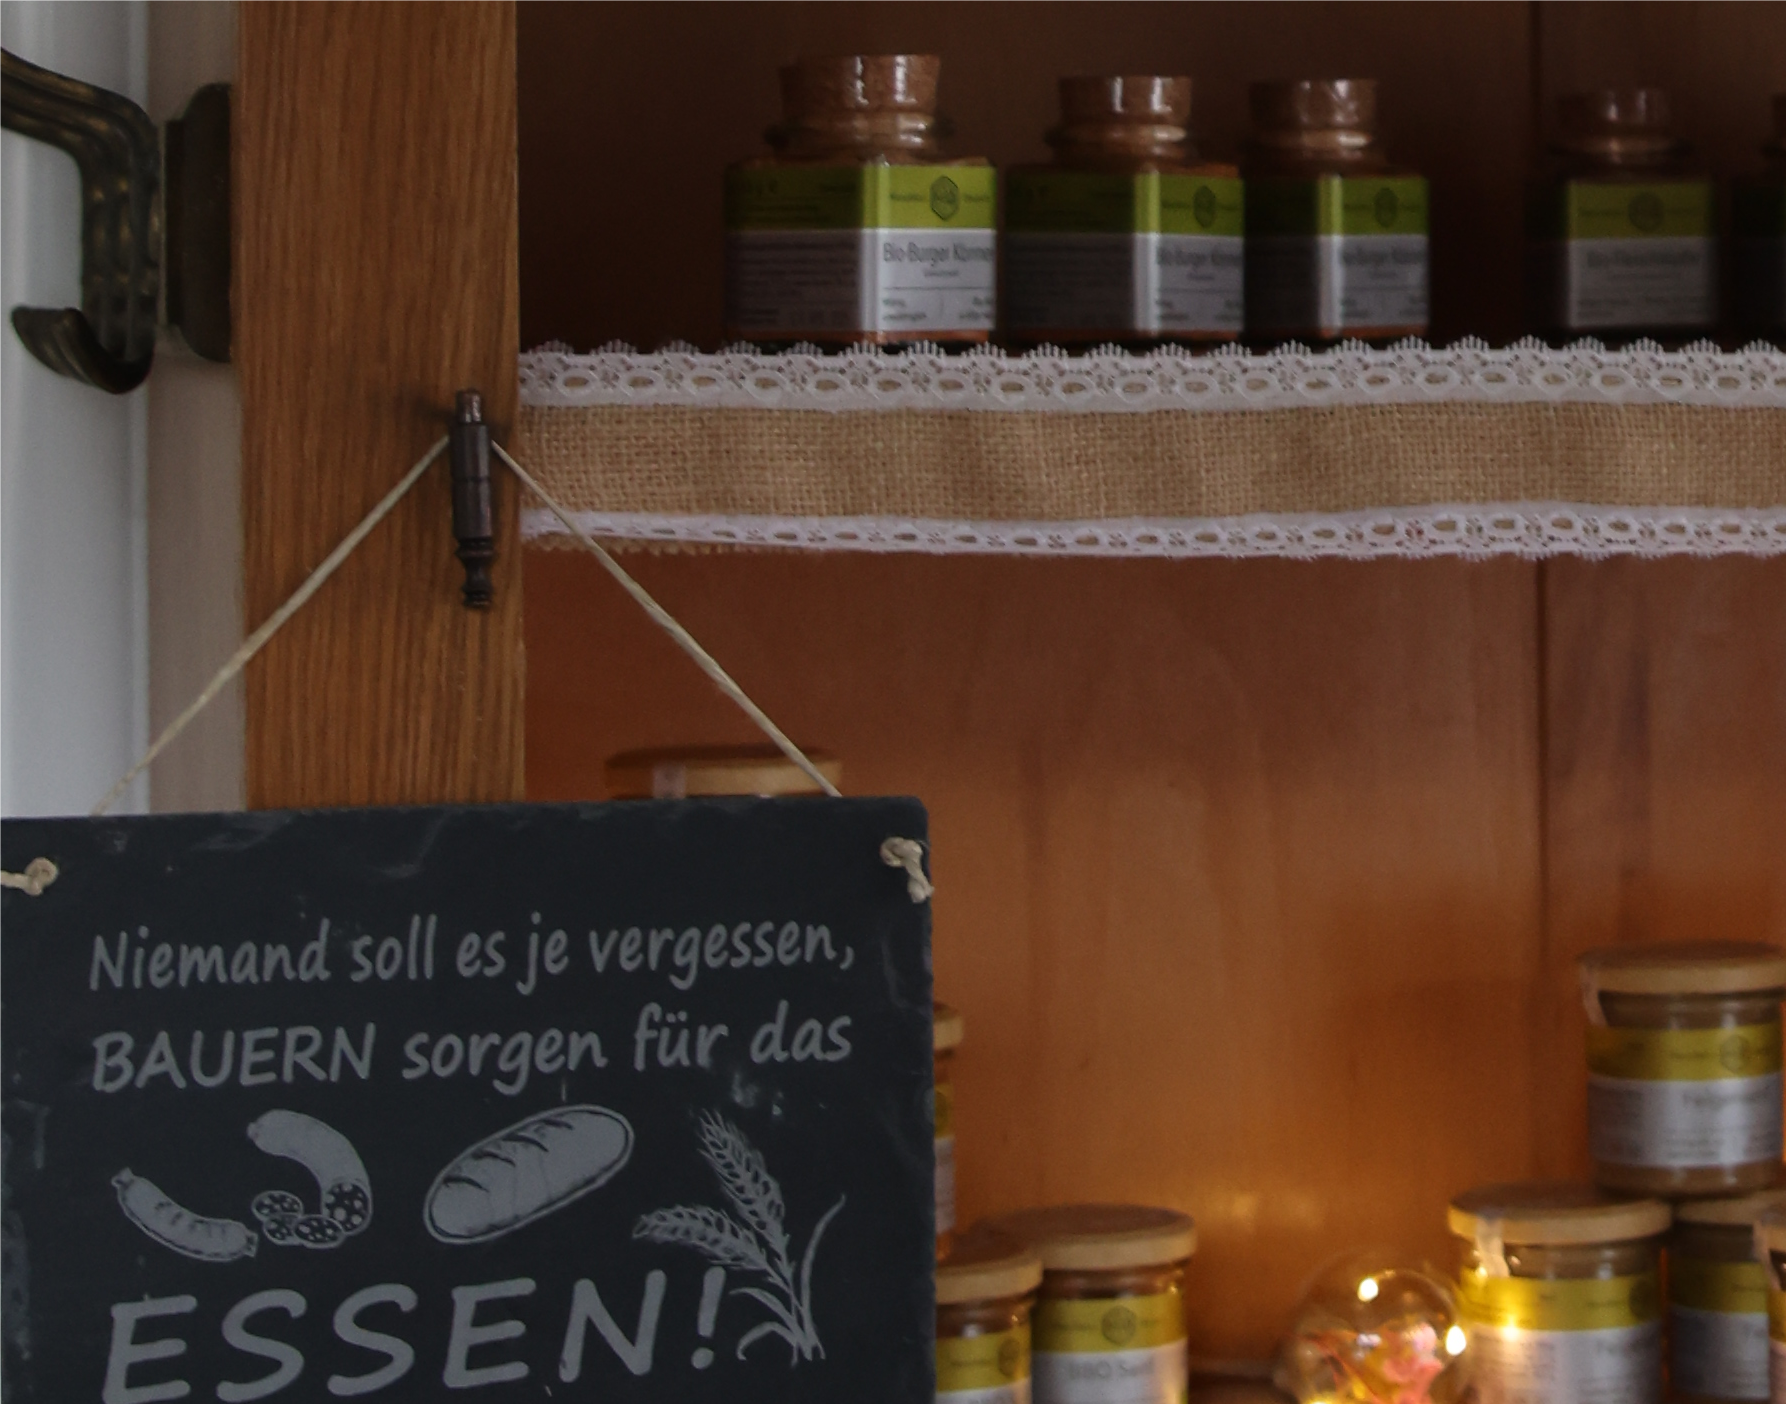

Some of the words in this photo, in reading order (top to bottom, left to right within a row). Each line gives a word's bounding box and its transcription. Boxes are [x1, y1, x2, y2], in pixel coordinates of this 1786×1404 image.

[90, 918, 330, 990] Niemand
[350, 914, 437, 982] soll
[457, 930, 506, 978] es
[516, 911, 569, 995] je
[589, 921, 854, 990] vergessen,
[92, 1022, 376, 1093] BAUERN
[401, 1028, 608, 1095] sorgen
[634, 1002, 729, 1072] für
[750, 999, 852, 1064] das
